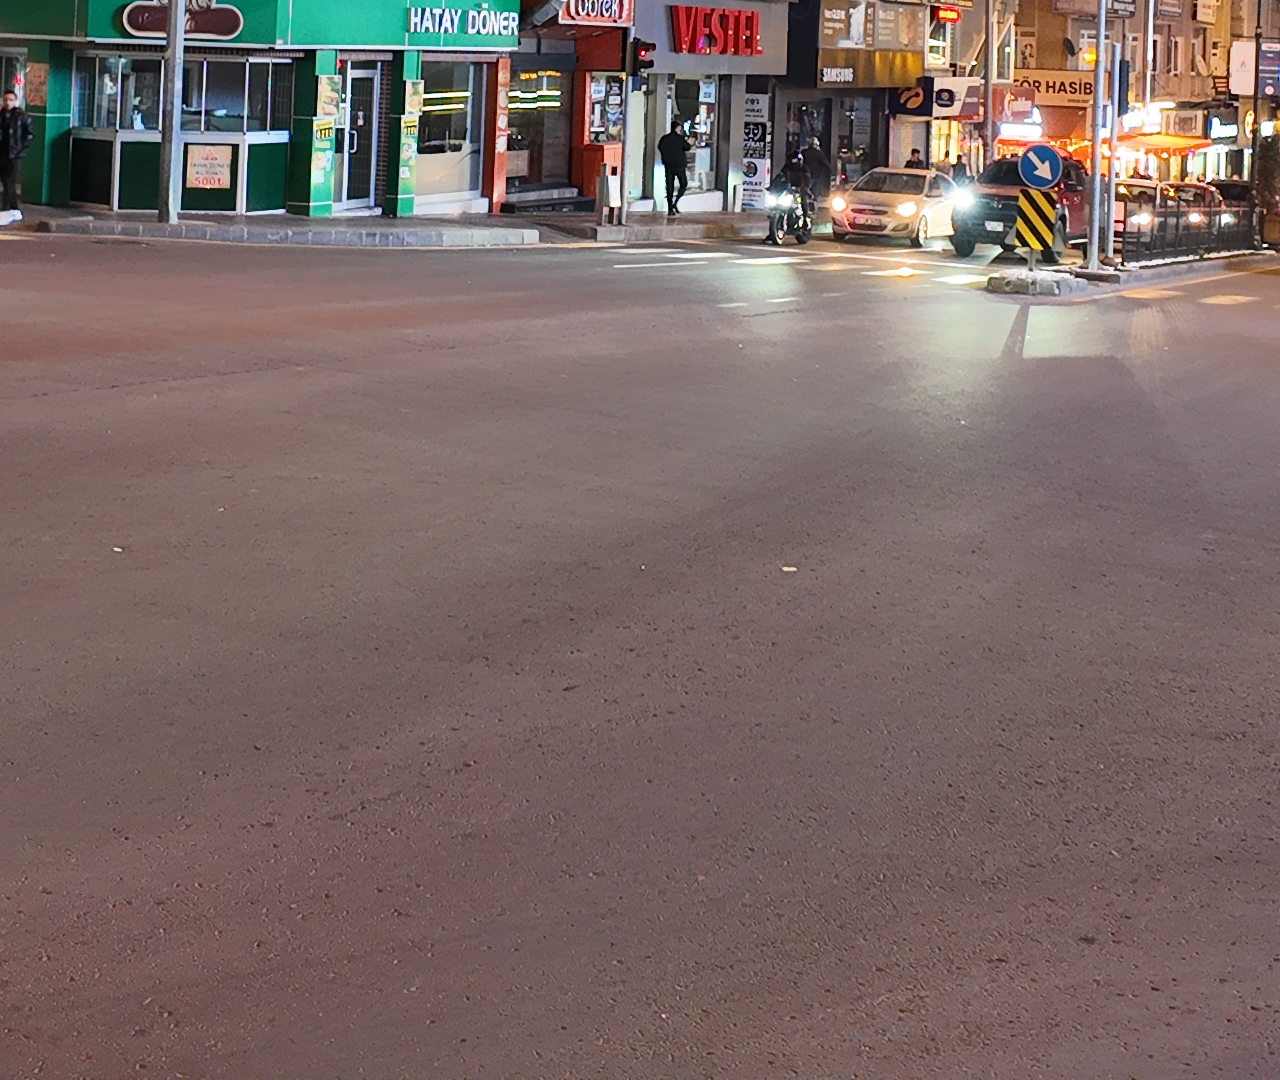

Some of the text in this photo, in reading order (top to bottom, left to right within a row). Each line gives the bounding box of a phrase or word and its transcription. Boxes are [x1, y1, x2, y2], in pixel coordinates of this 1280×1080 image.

[410, 2, 518, 36] HATAY DÖNER
[673, 4, 764, 57] VESTEL
[822, 68, 853, 82] SAMSUNG
